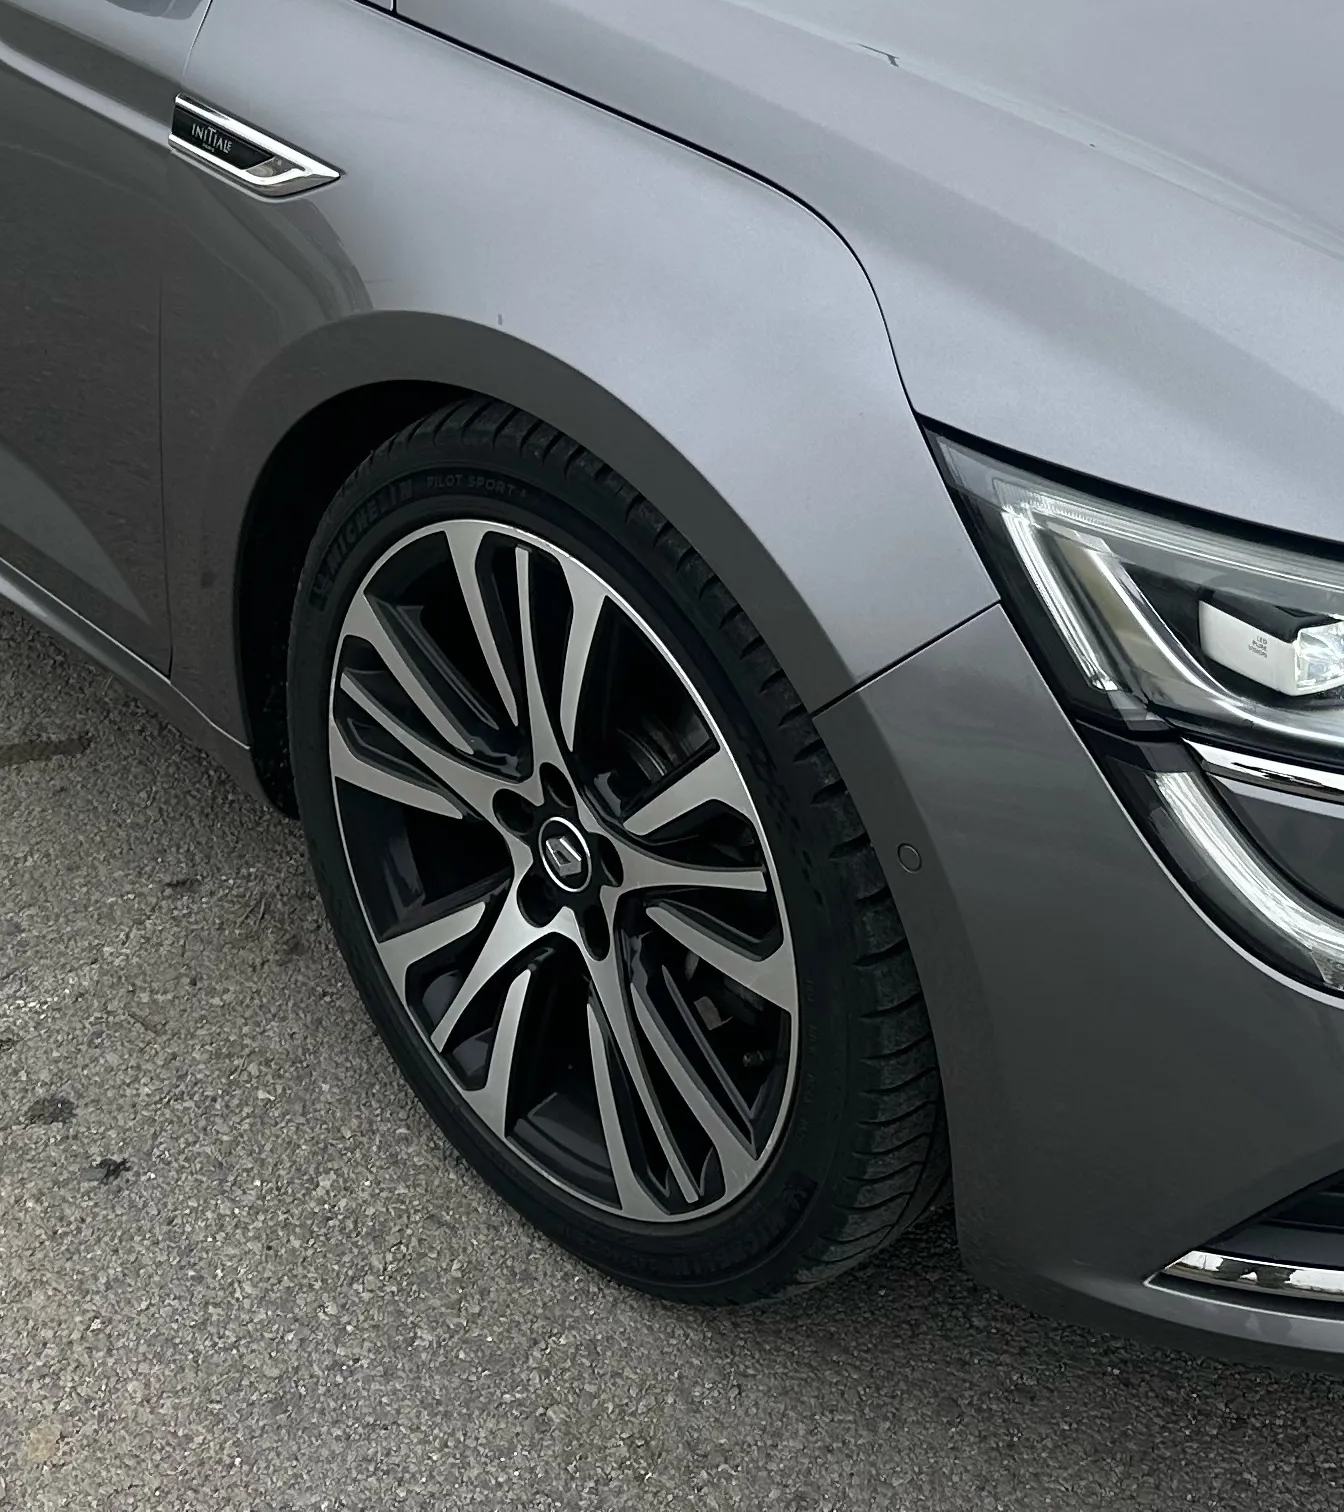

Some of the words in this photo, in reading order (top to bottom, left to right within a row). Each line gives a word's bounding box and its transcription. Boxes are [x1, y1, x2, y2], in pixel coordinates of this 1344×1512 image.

[191, 122, 232, 153] INITIALE
[425, 474, 463, 489] PILOT
[467, 474, 518, 496] SPORT
